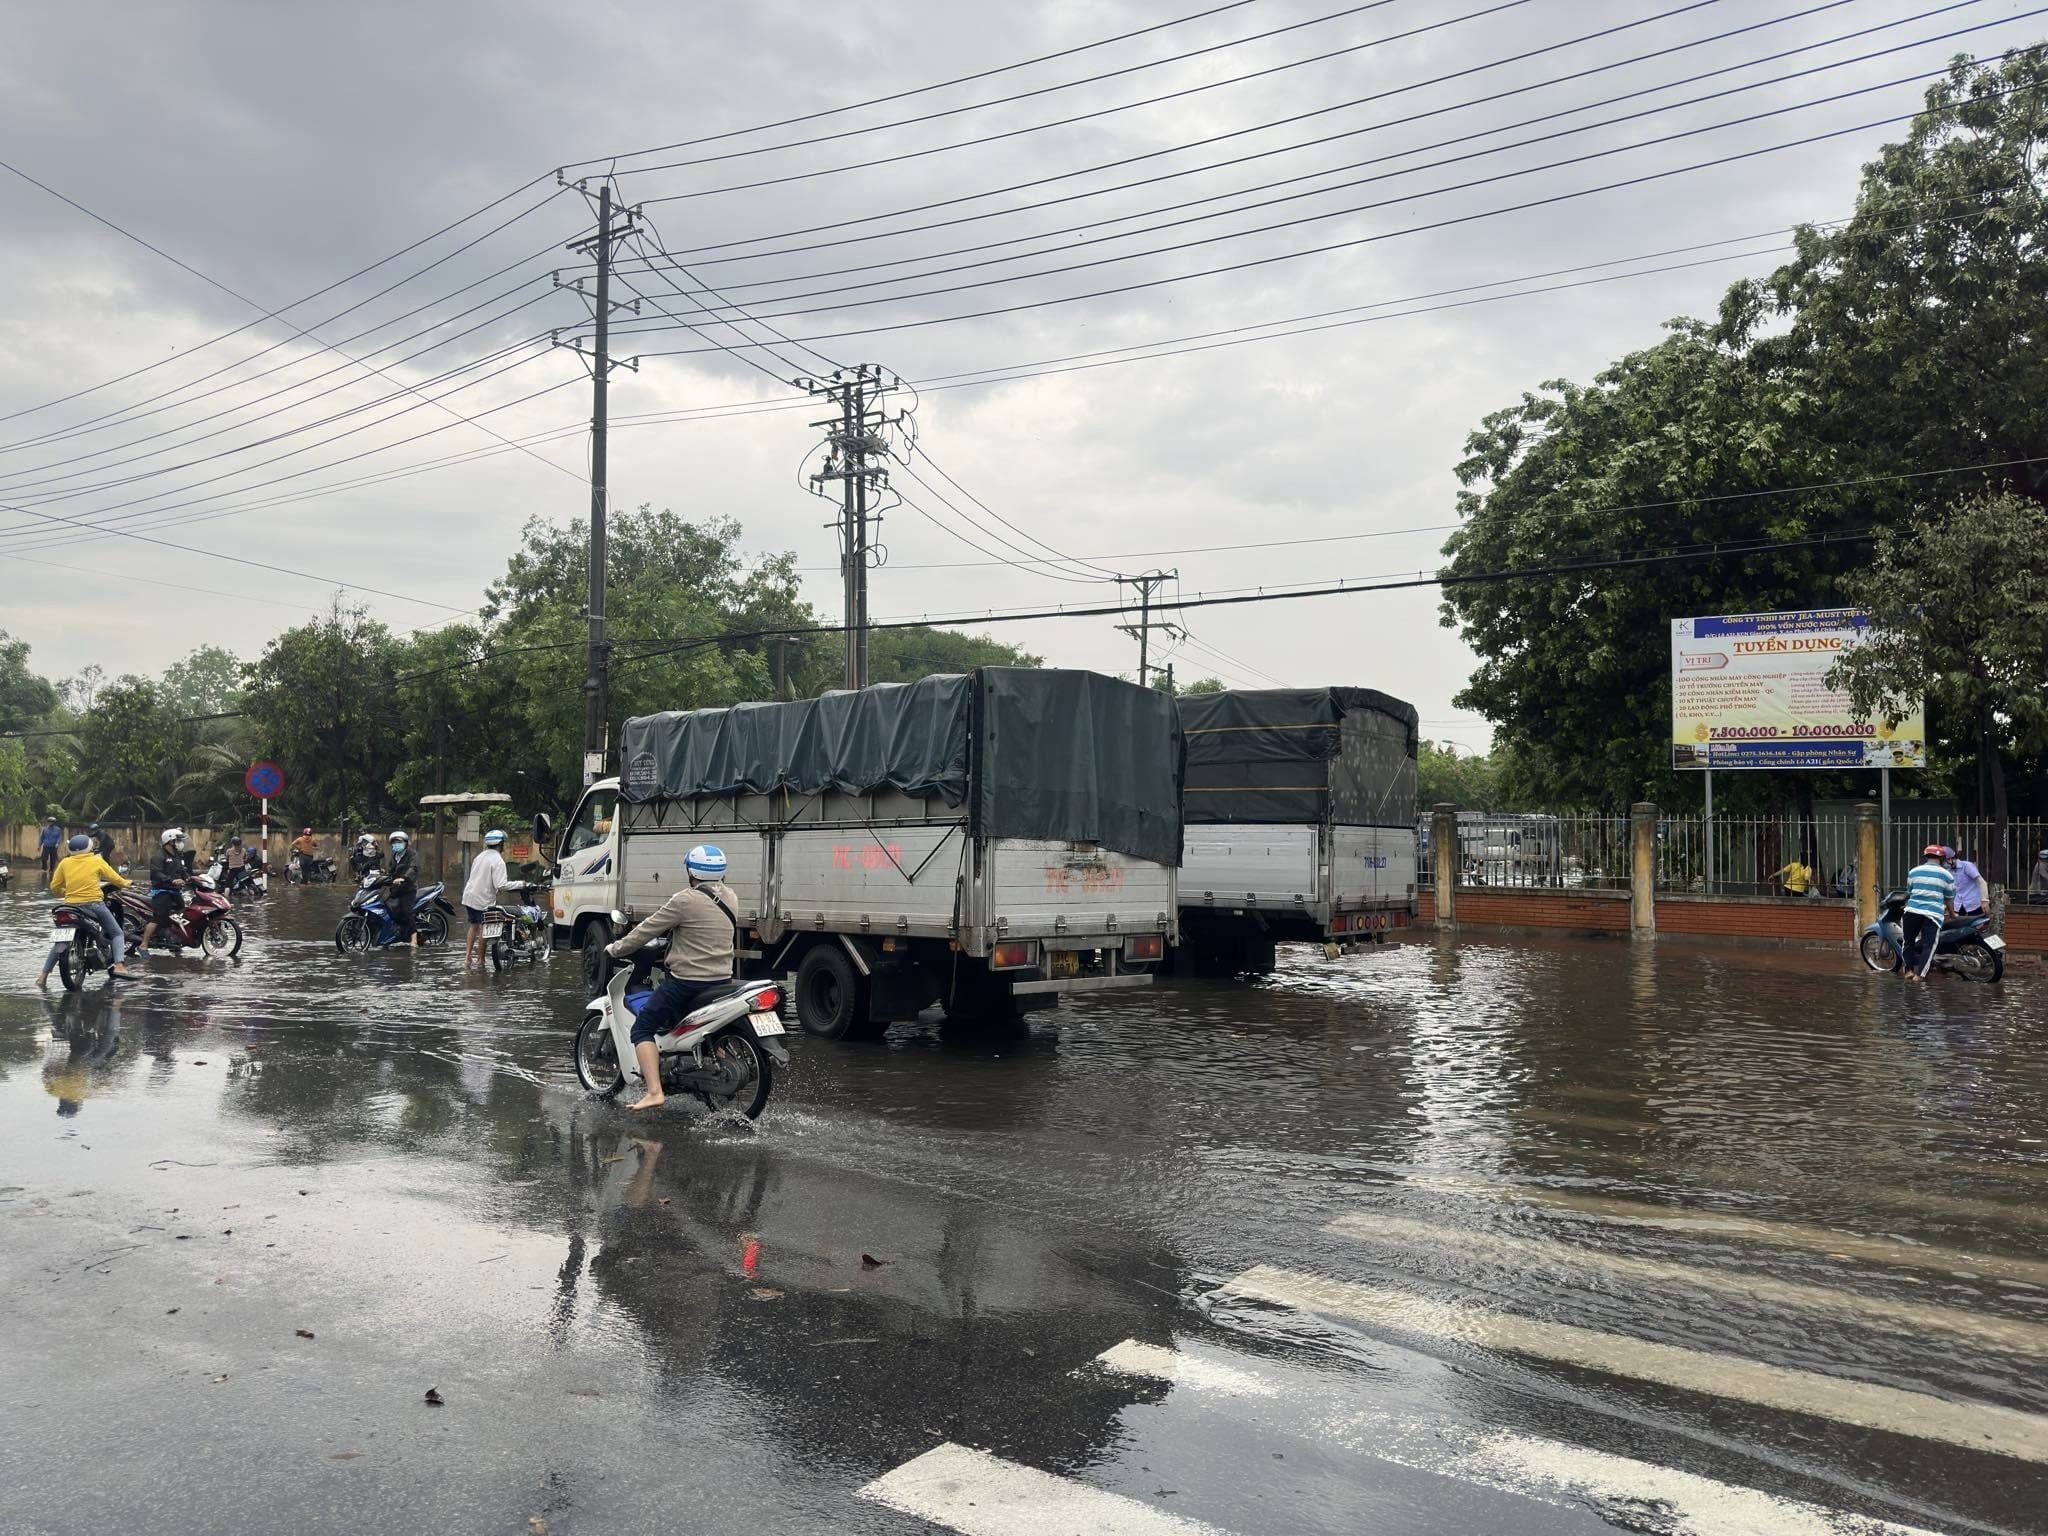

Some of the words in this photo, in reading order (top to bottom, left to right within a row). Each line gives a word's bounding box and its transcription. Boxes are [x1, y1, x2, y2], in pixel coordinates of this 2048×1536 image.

[1722, 616, 1743, 624] CÔNG
[1733, 636, 1788, 653] TUYỂN
[1791, 637, 1841, 652] DỤNG
[1685, 657, 1694, 666] VỊ
[1697, 655, 1711, 664] TRÍ
[1792, 724, 1875, 737] 10.000.000
